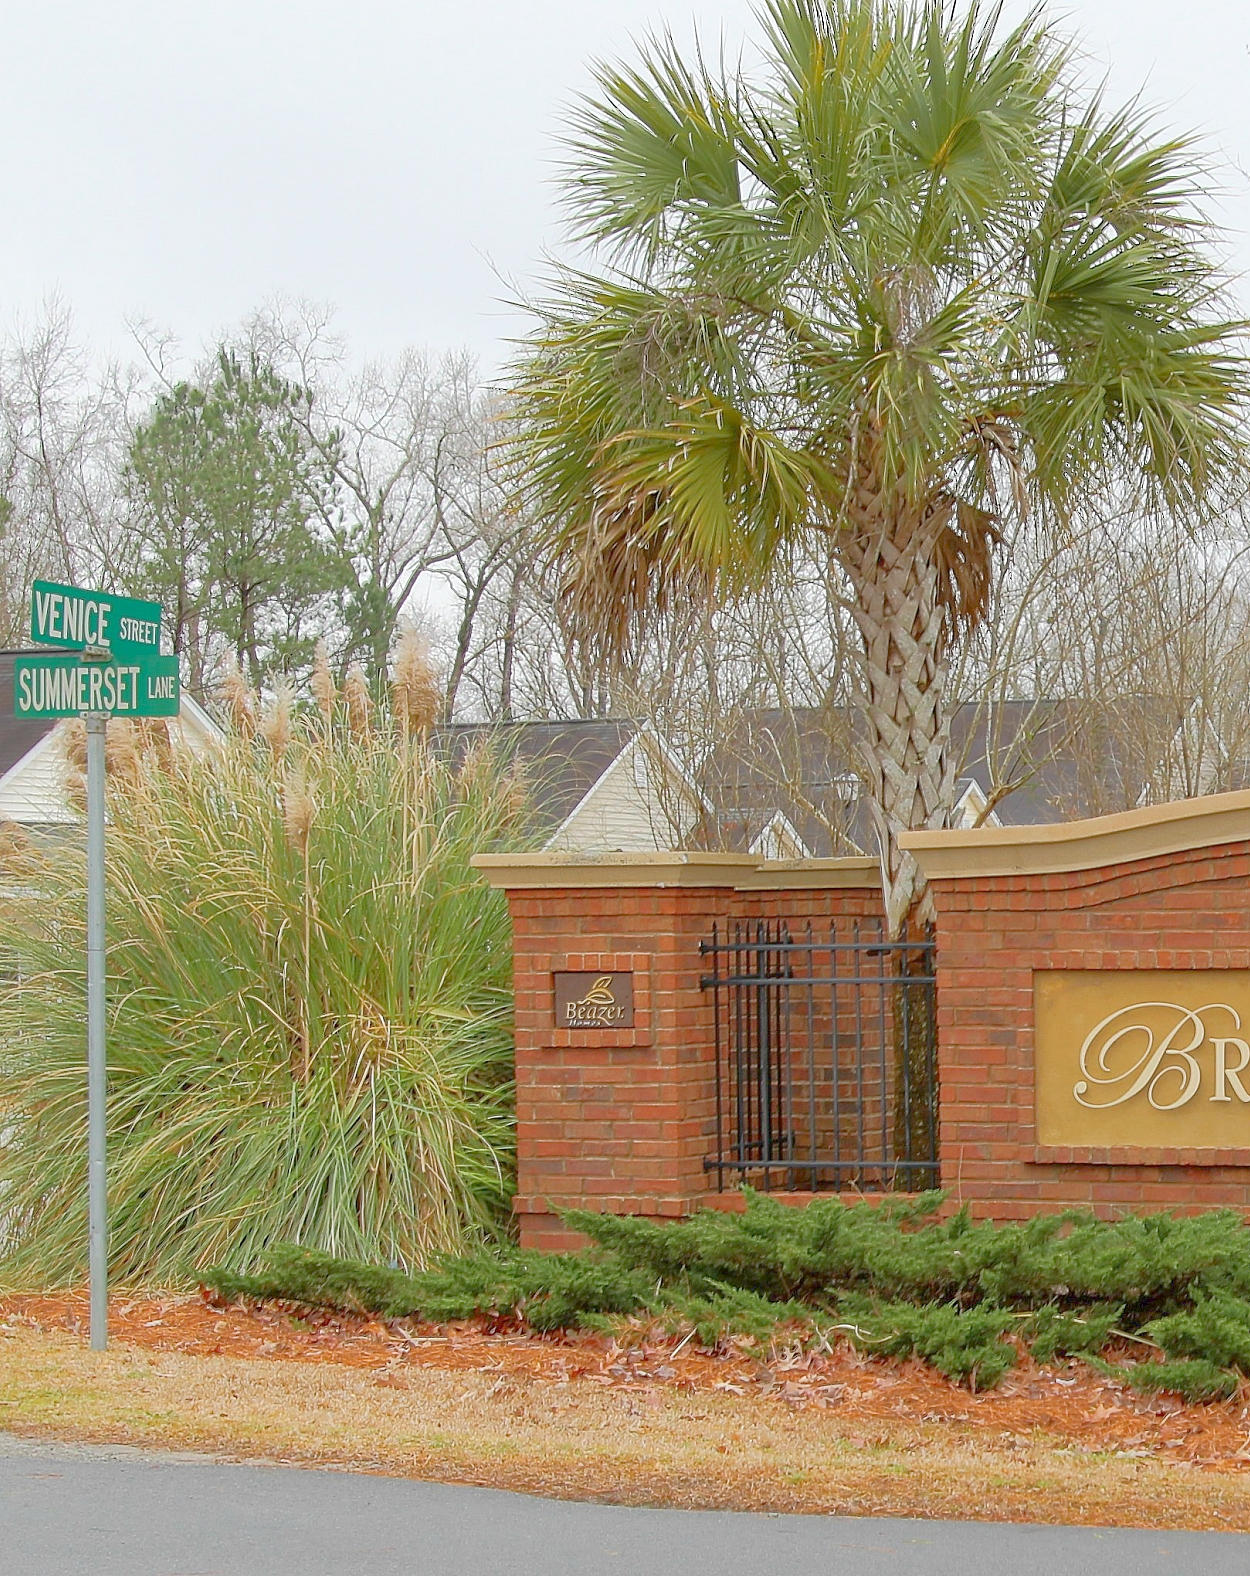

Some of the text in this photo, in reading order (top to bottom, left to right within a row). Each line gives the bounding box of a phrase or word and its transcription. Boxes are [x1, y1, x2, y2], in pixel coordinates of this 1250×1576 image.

[36, 590, 158, 647] VENICE STREET
[19, 667, 176, 711] SUMMERSET LANE
[566, 1002, 623, 1026] Beazer
